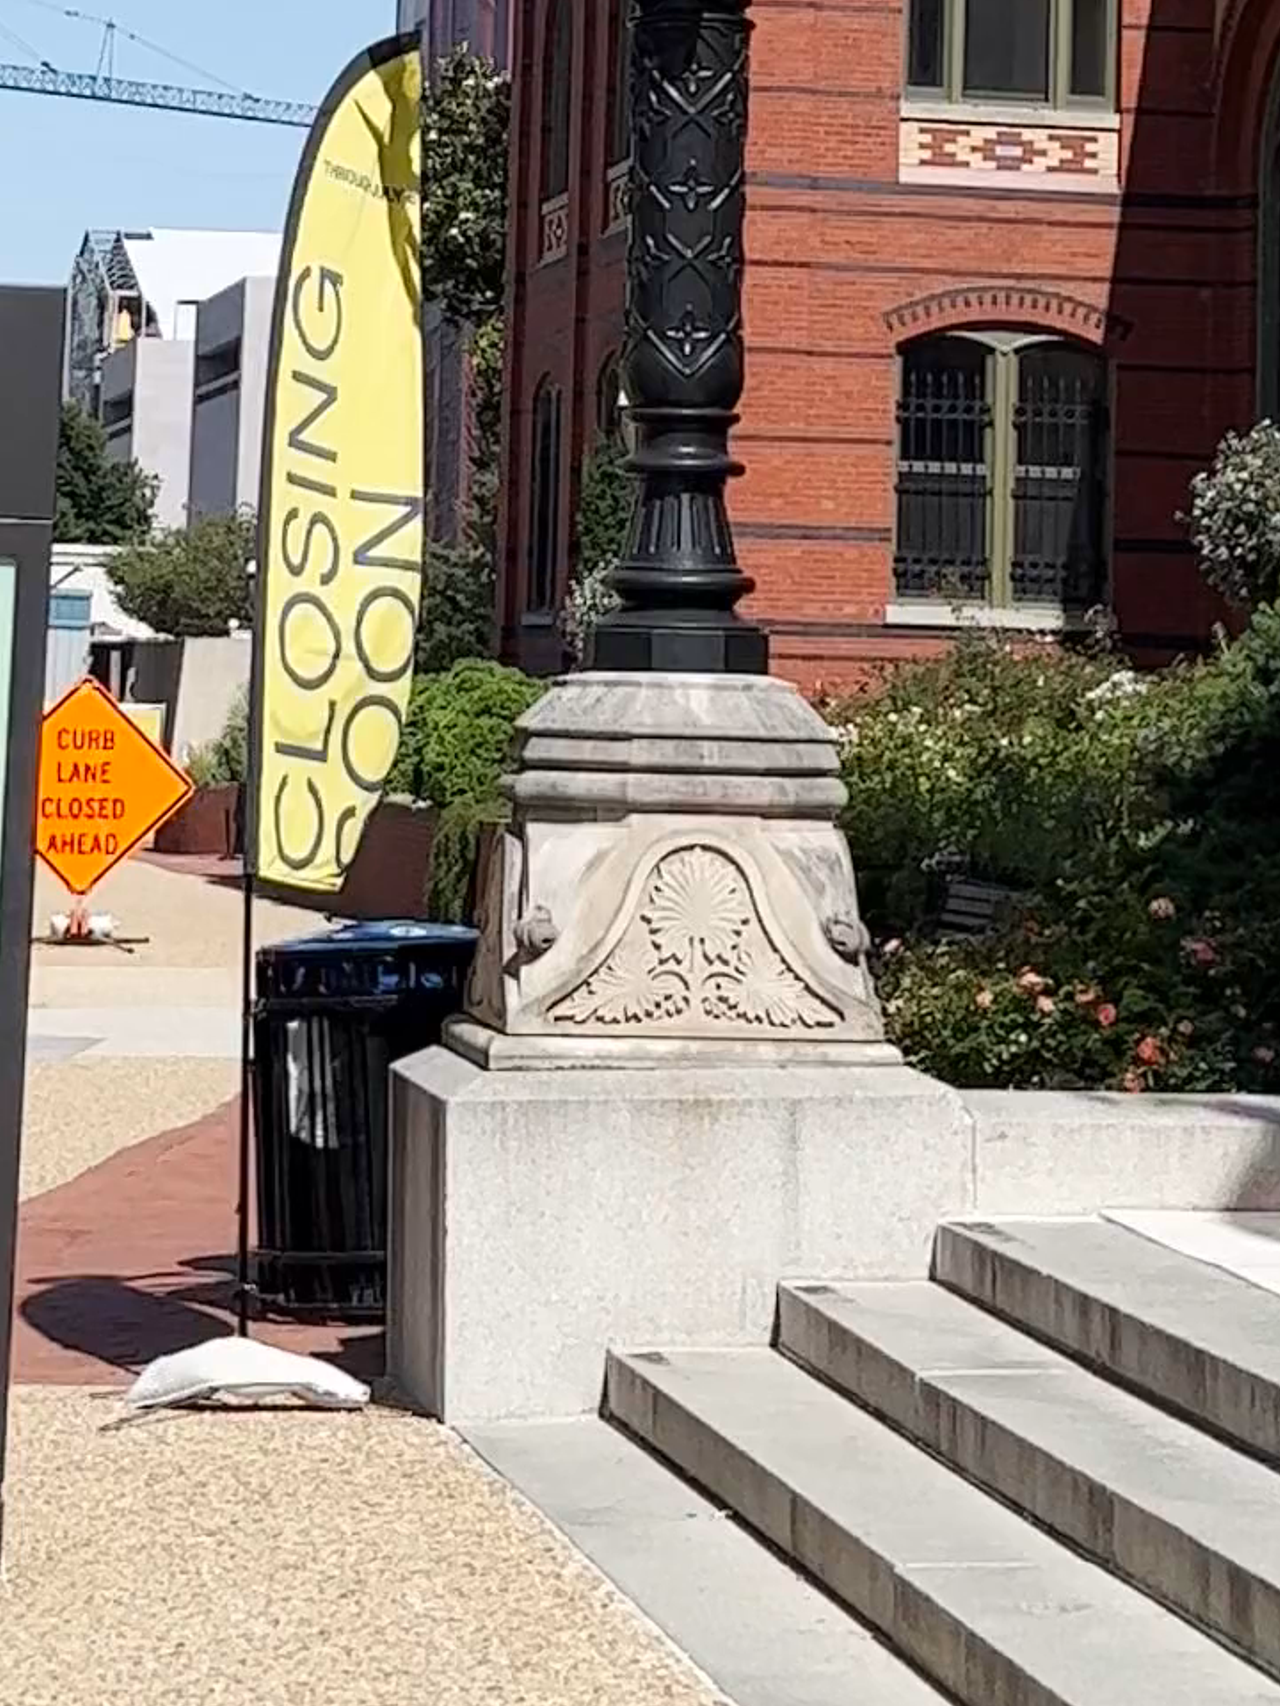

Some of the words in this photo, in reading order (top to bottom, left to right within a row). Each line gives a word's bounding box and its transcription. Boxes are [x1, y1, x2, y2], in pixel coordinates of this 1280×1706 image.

[274, 266, 344, 871] CLOSING
[57, 727, 116, 751] CURB
[57, 761, 113, 784] LANE
[41, 797, 125, 820] CLOSED
[45, 834, 119, 856] AHEAD
